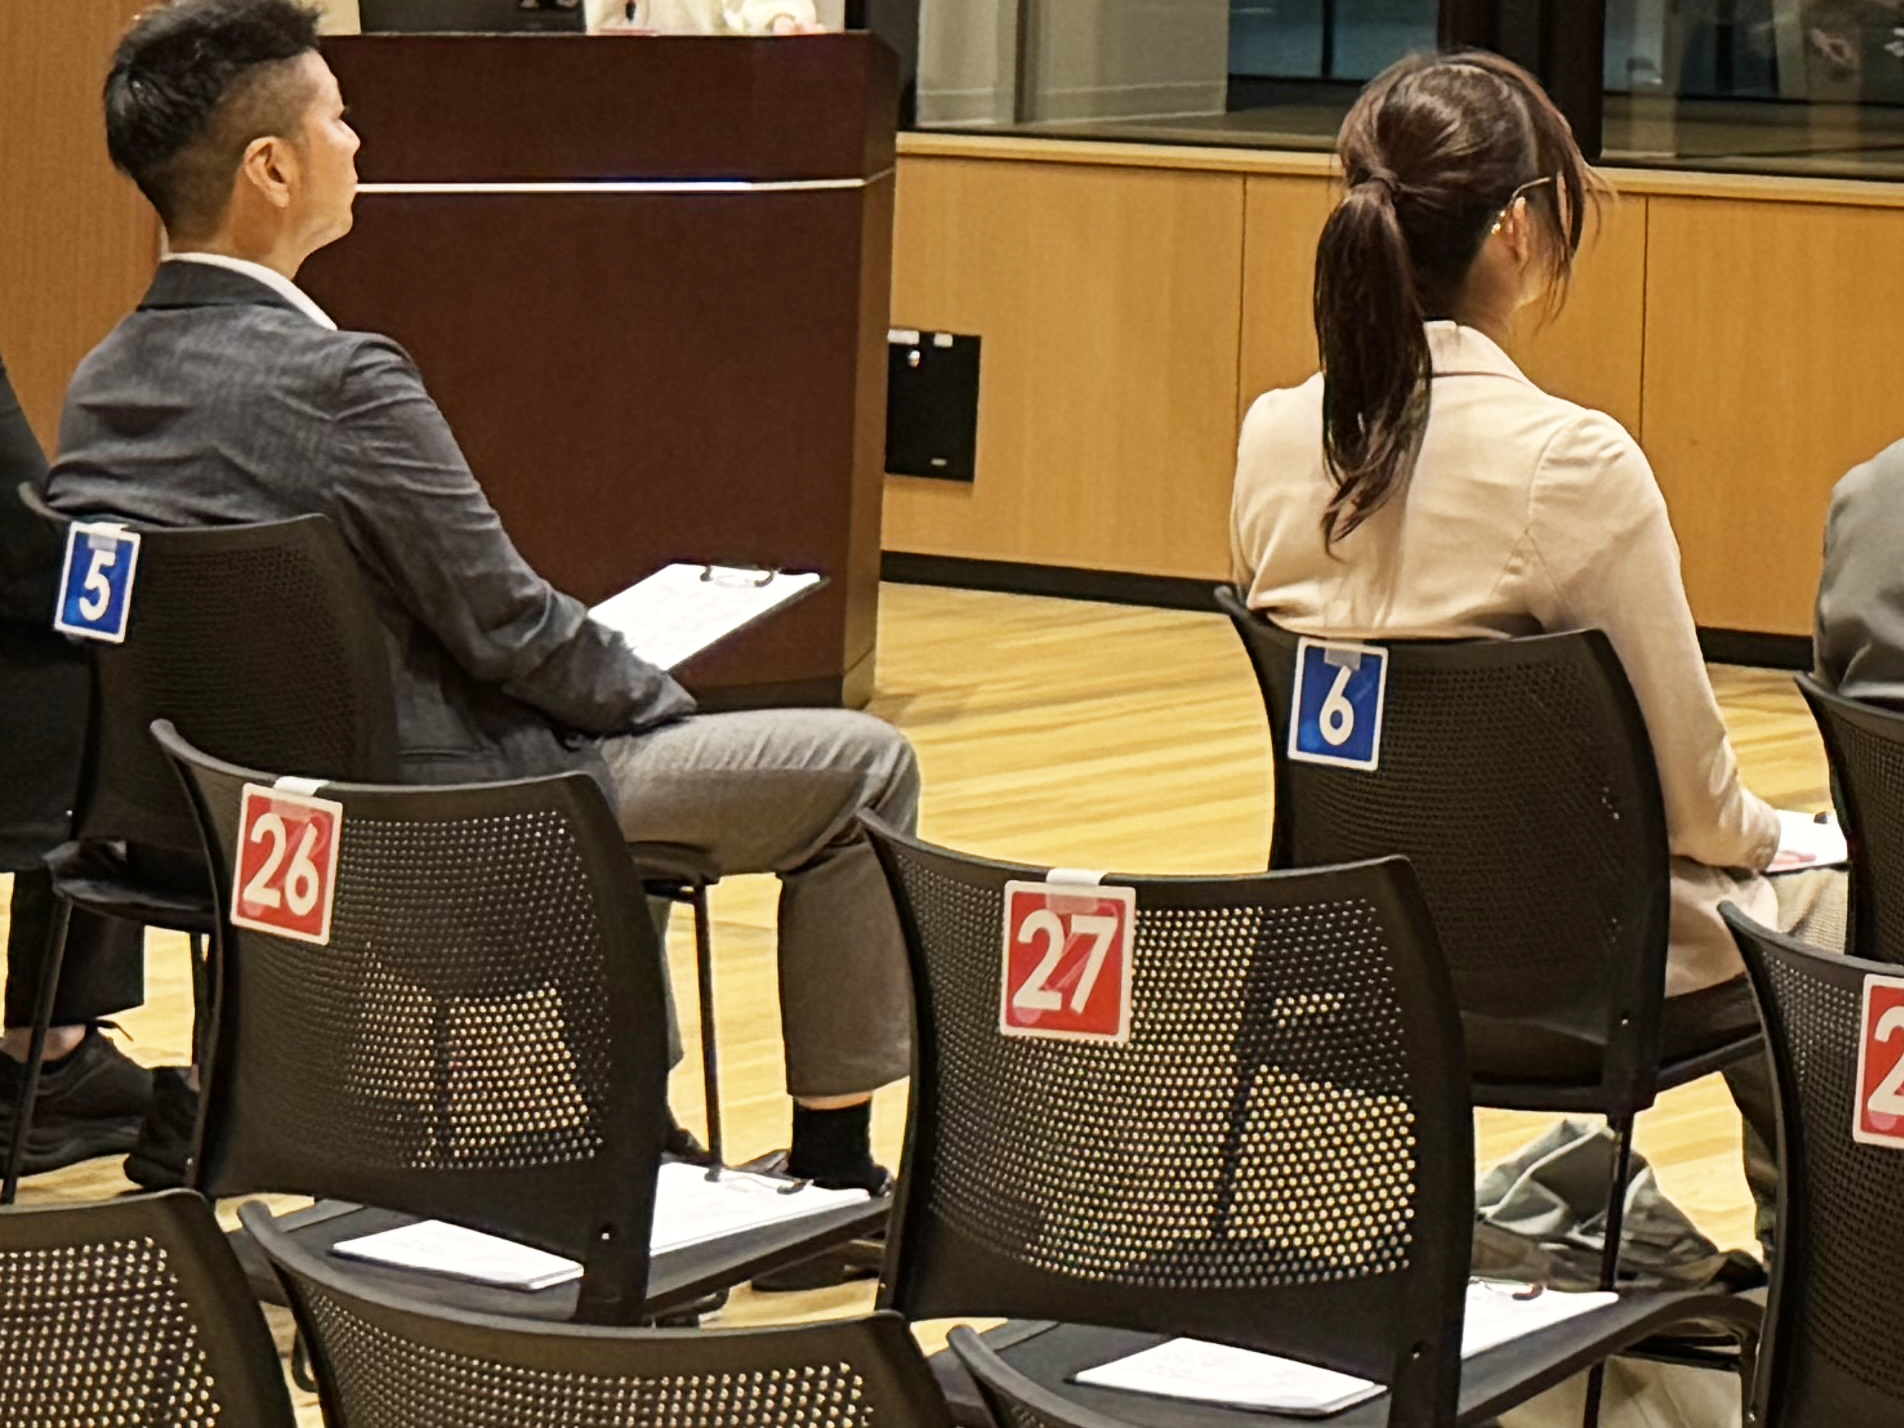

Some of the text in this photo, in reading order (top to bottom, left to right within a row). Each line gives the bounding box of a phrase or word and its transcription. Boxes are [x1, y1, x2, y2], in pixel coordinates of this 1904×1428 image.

[79, 550, 116, 622] 5
[1319, 665, 1355, 746] 6
[243, 812, 320, 917] 26
[1012, 909, 1118, 1015] 27
